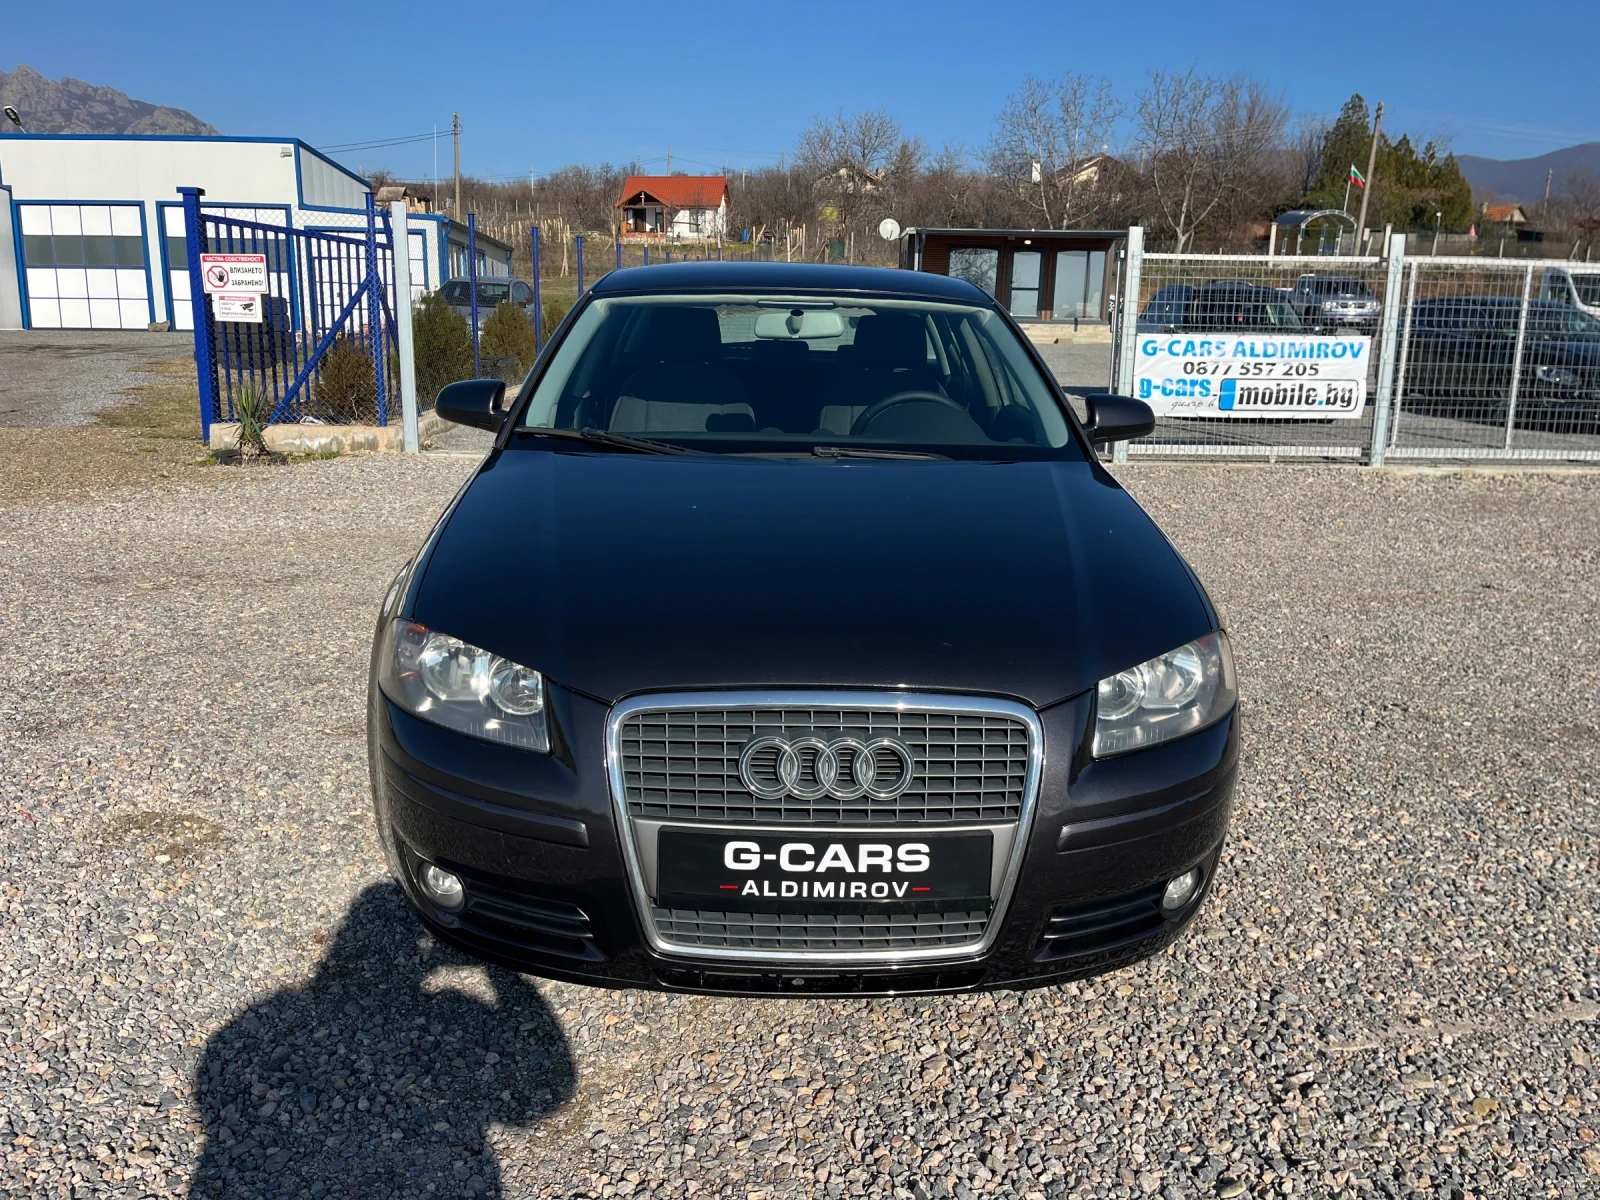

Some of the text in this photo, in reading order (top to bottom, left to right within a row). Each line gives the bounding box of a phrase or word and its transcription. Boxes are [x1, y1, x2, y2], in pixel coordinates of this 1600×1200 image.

[1142, 339, 1364, 359] G-CARS ALDIMIROV
[1183, 361, 1320, 376] 0877 557 205
[1237, 380, 1352, 408] mobile.bg
[723, 840, 931, 873] G-CARS
[741, 879, 910, 898] ALDIMIROV
